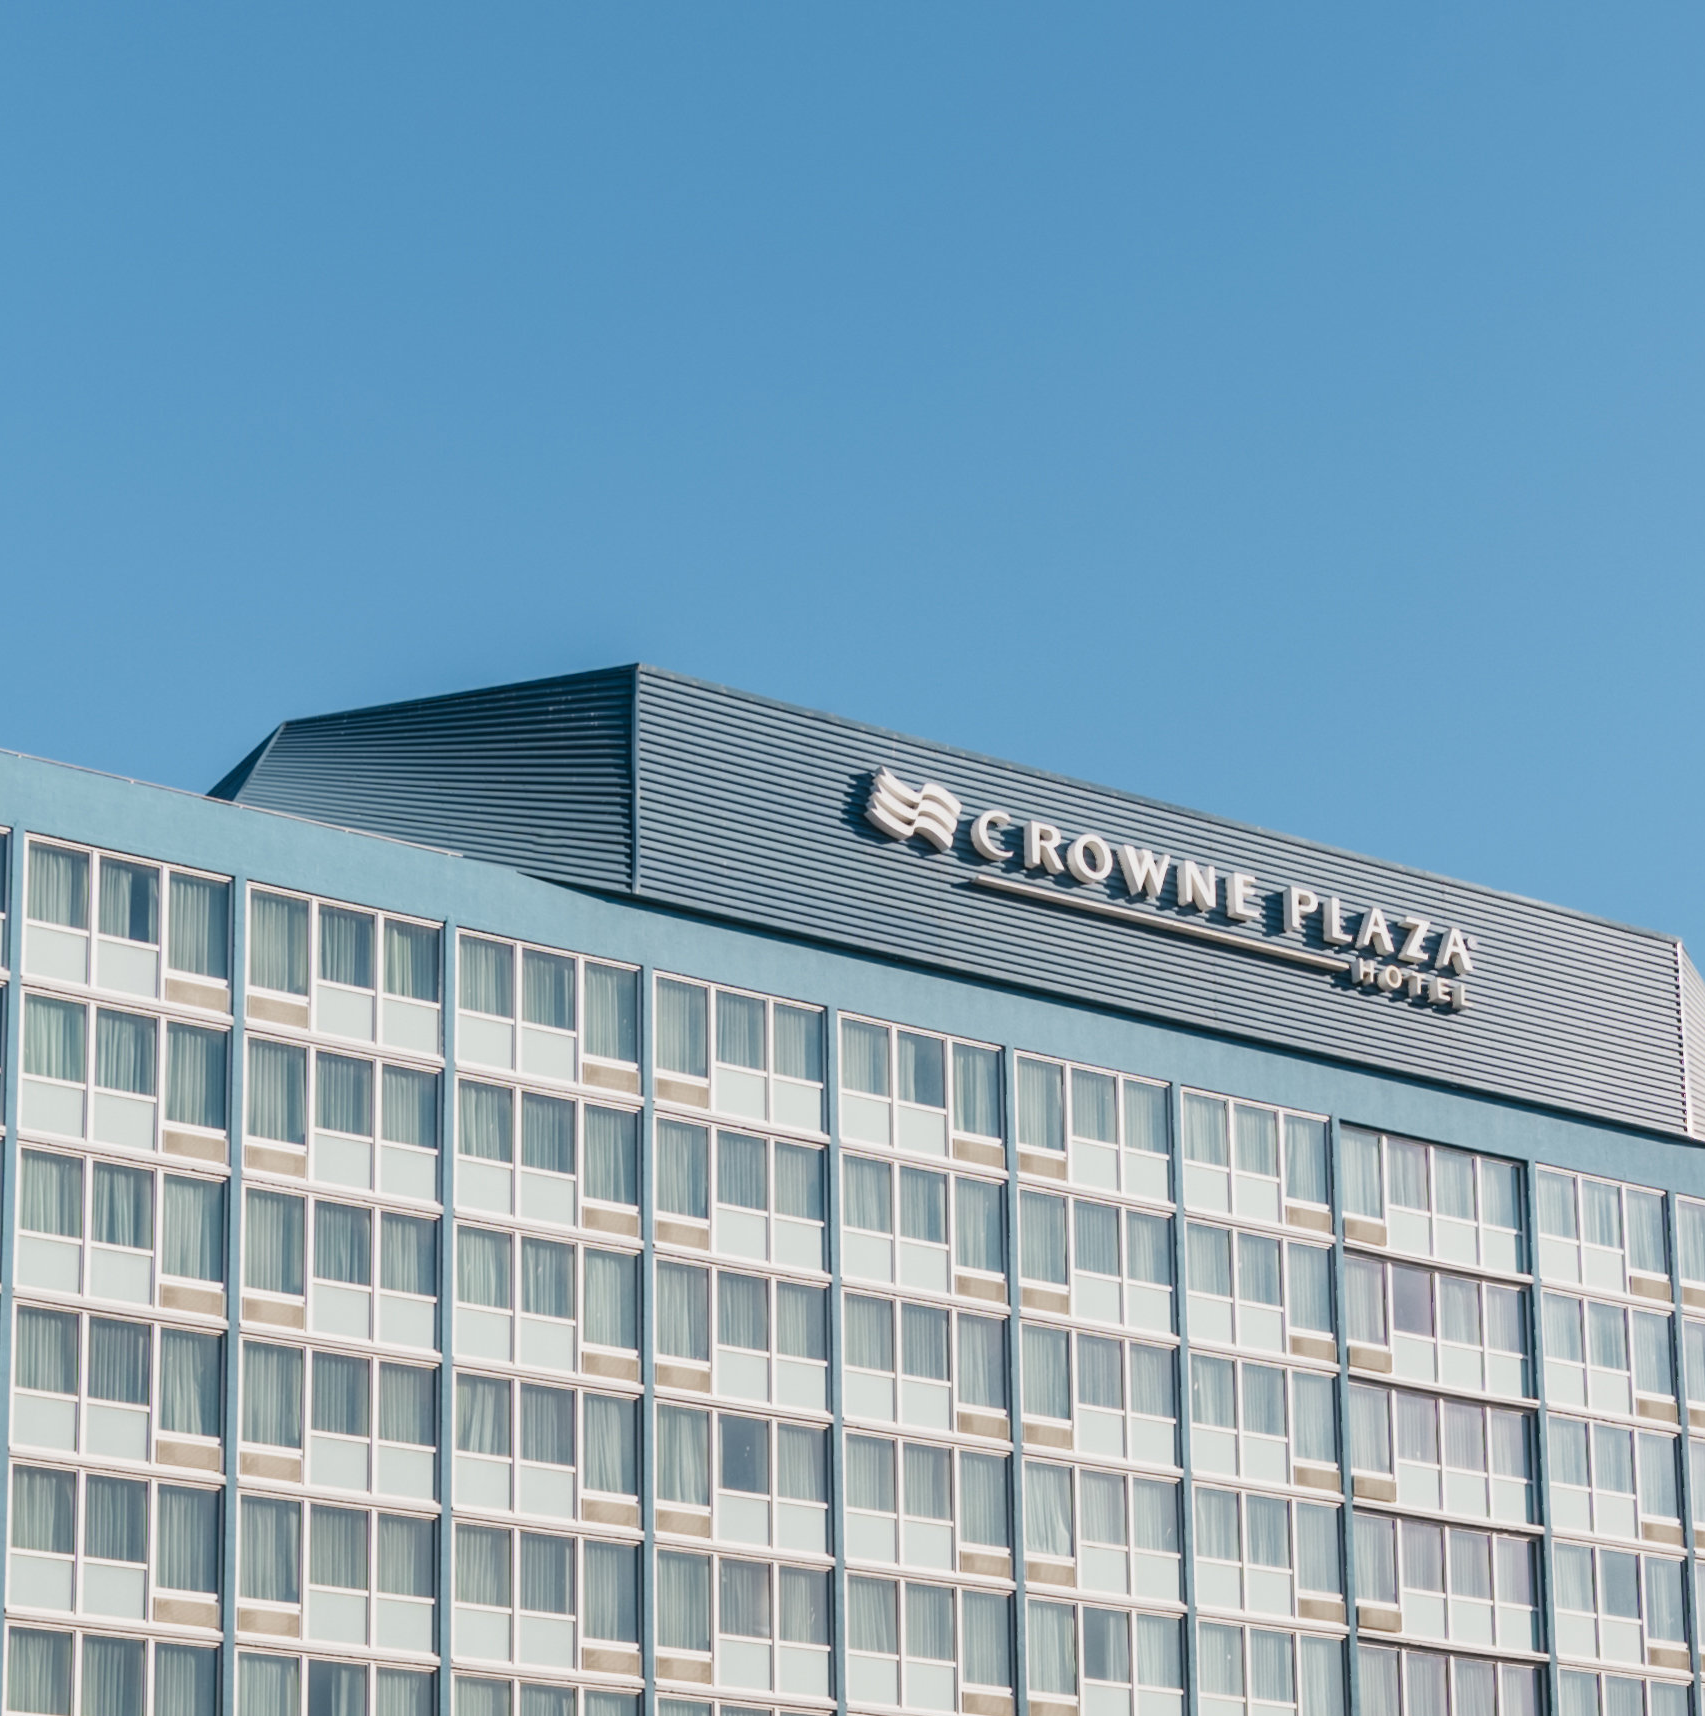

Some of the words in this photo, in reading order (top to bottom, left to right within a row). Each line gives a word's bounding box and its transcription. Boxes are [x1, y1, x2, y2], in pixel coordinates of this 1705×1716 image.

[971, 809, 1260, 921] CROWNE
[1283, 885, 1473, 975] PLAZA
[1351, 957, 1473, 1009] HOTEL
